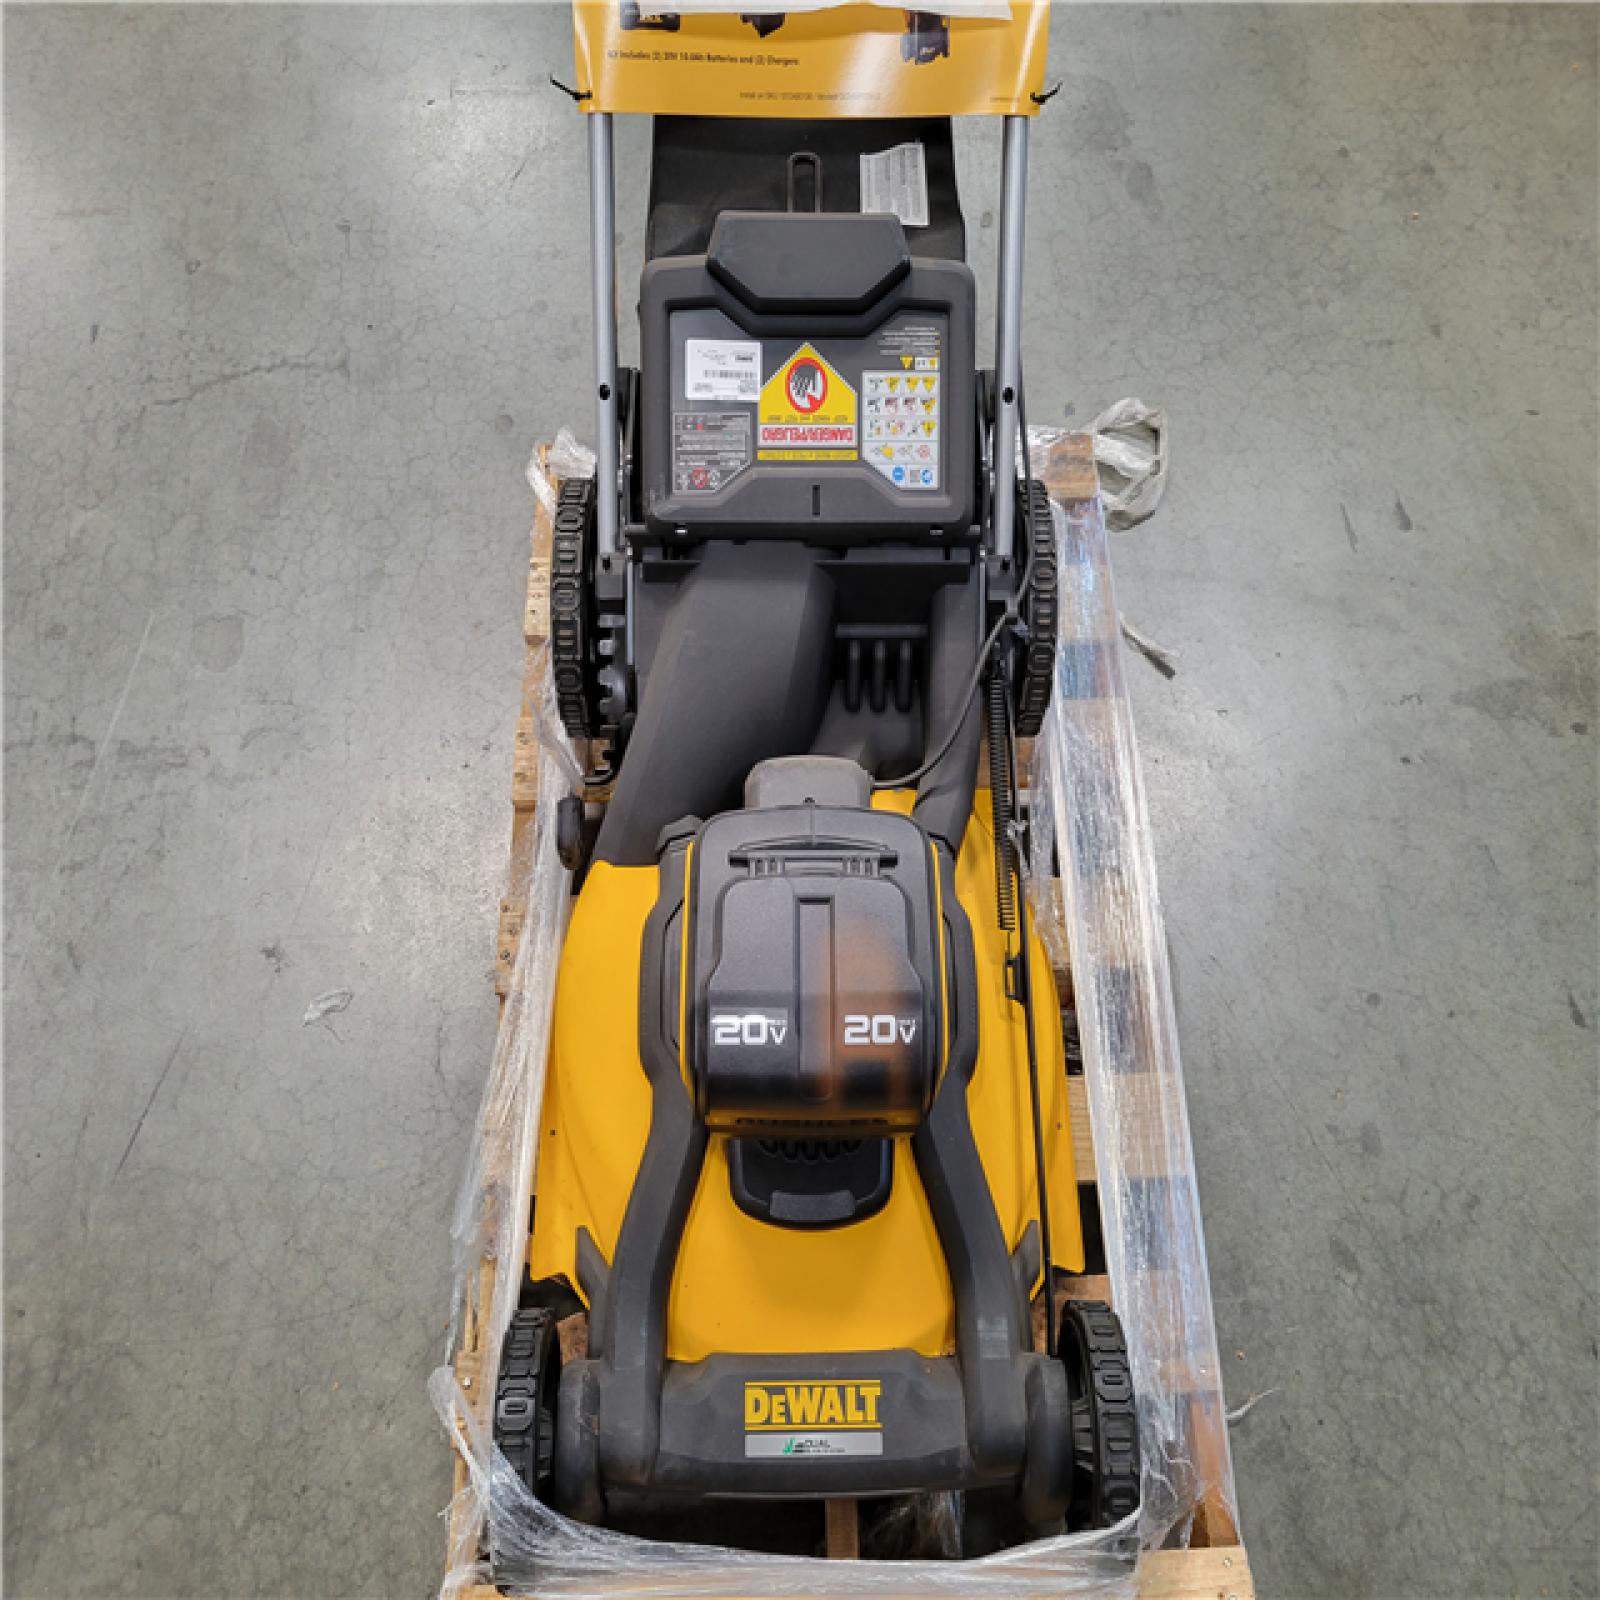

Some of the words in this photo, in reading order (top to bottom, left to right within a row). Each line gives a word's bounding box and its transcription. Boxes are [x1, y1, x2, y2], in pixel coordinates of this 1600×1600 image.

[620, 50, 650, 60] Includes
[707, 52, 738, 63] Batteries
[739, 55, 753, 63] and
[767, 54, 800, 67] Chargers
